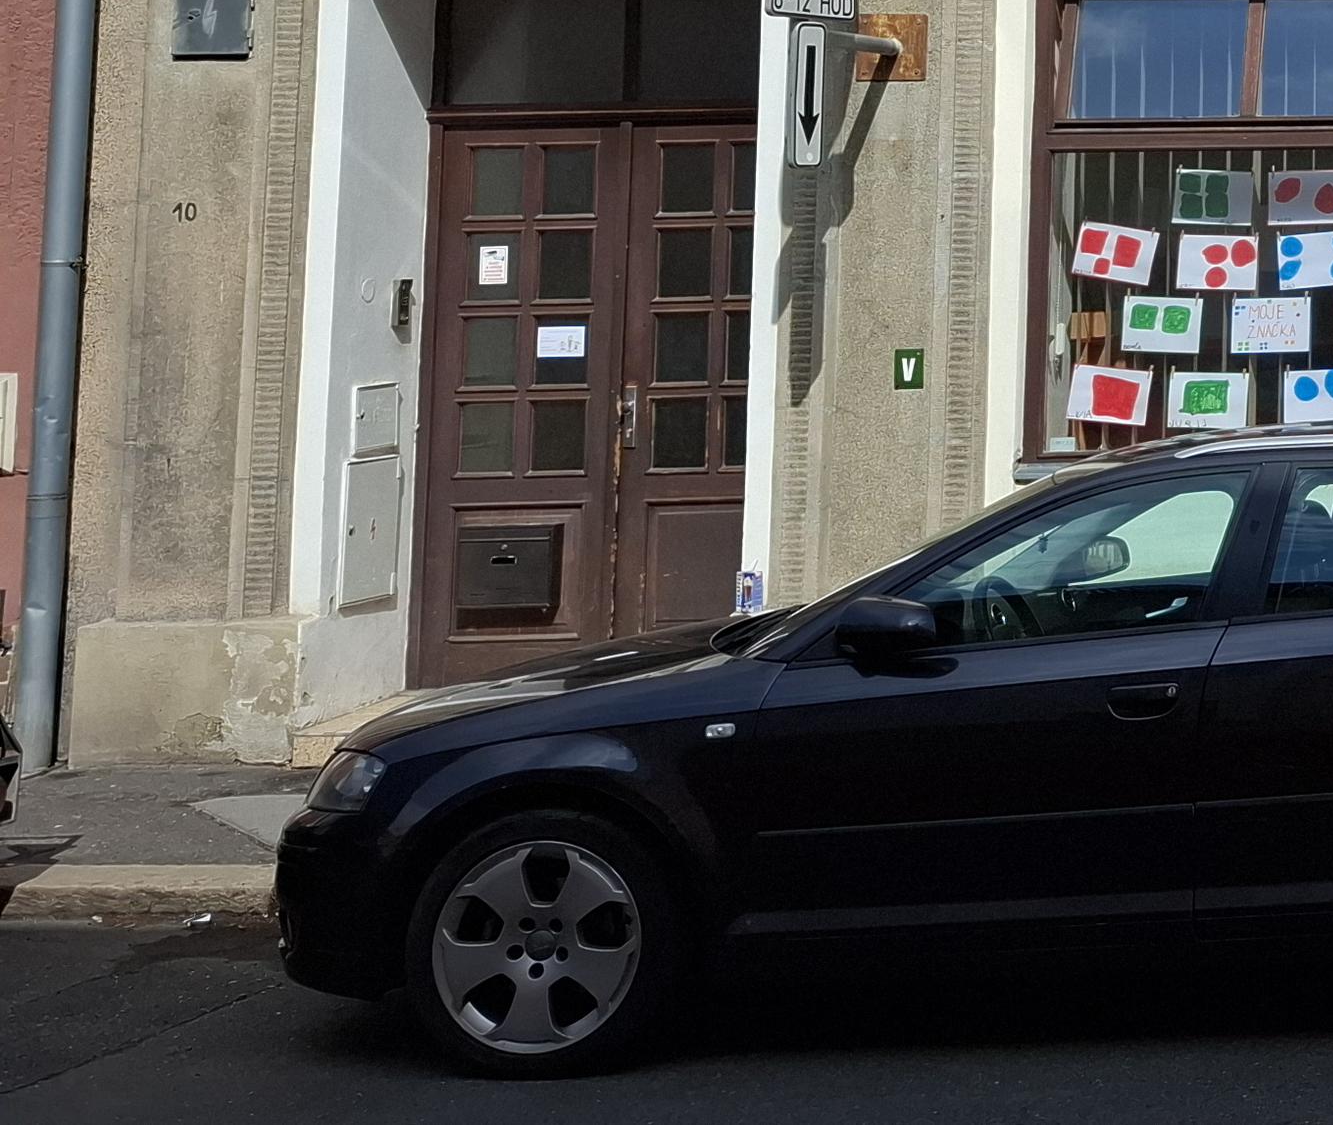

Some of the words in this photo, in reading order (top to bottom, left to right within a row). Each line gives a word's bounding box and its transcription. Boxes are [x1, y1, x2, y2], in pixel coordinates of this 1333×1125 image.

[172, 202, 197, 223] 10
[1248, 304, 1285, 320] MOJE
[1247, 321, 1296, 338] ZNAČKA
[901, 357, 916, 382] V
